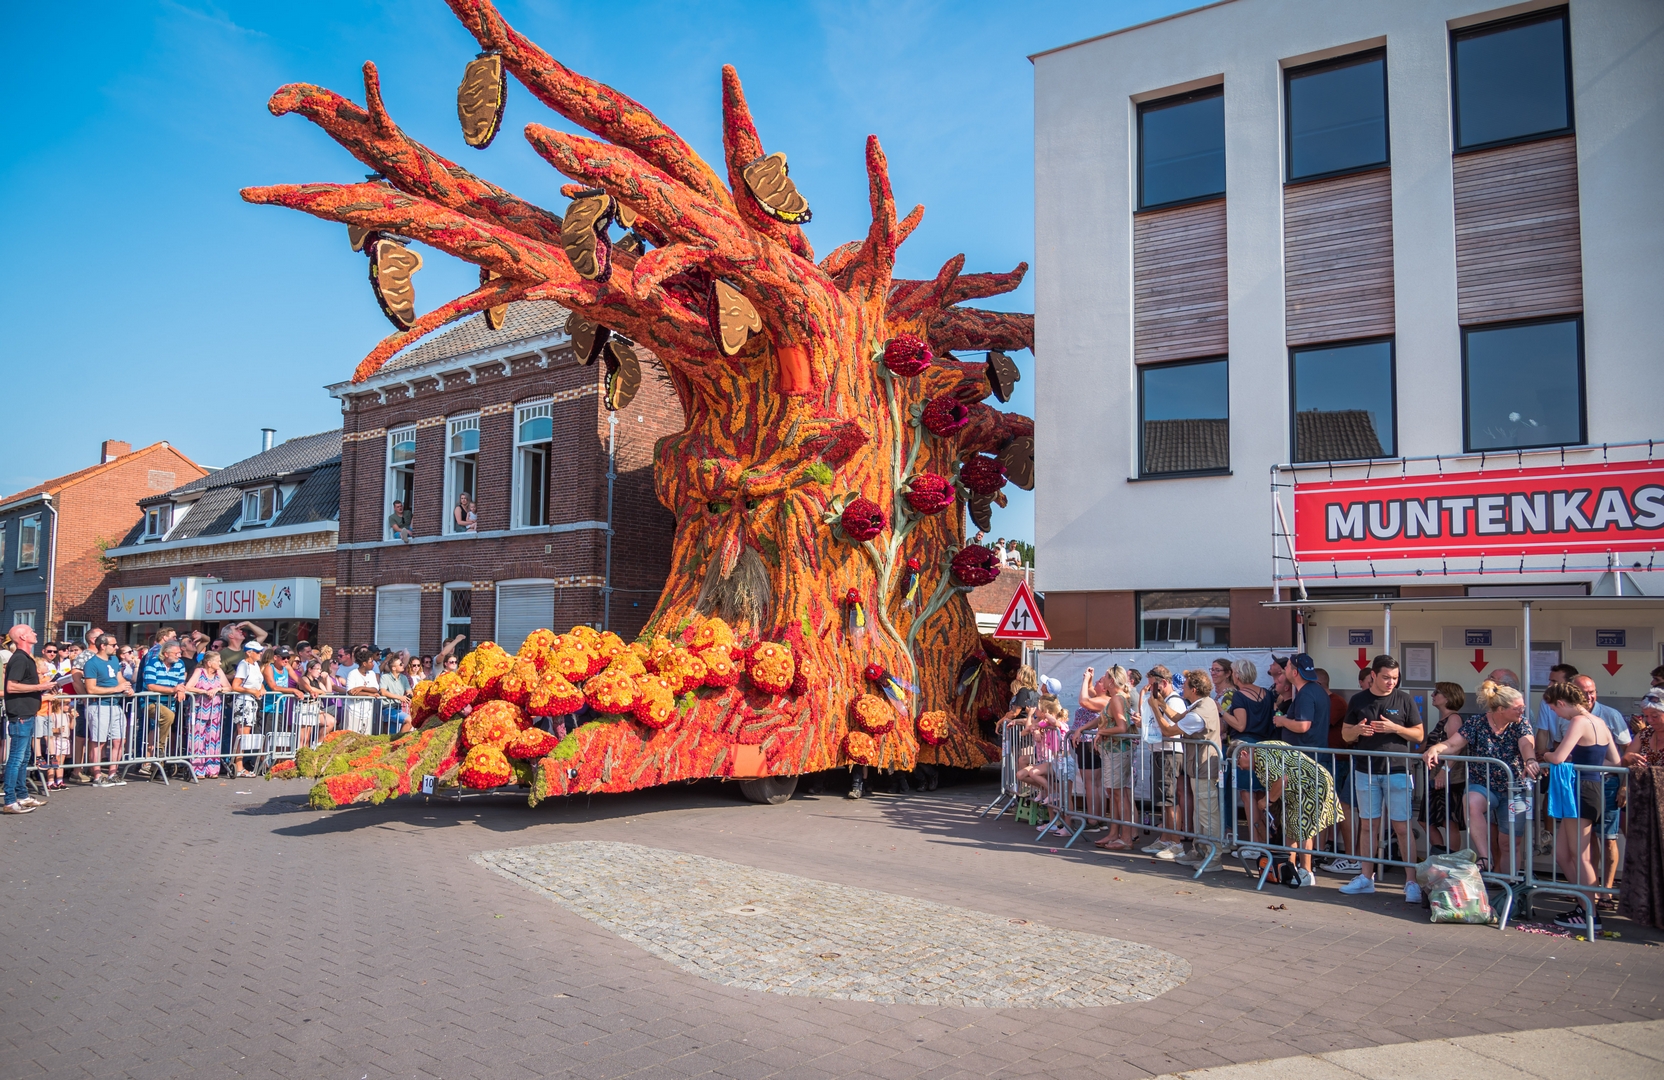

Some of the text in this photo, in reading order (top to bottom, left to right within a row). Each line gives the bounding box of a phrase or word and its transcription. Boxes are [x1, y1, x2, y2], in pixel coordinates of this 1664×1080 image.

[1326, 484, 1664, 541] MUNTENKAS
[215, 589, 255, 614] SUSHI
[425, 778, 434, 788] 10
